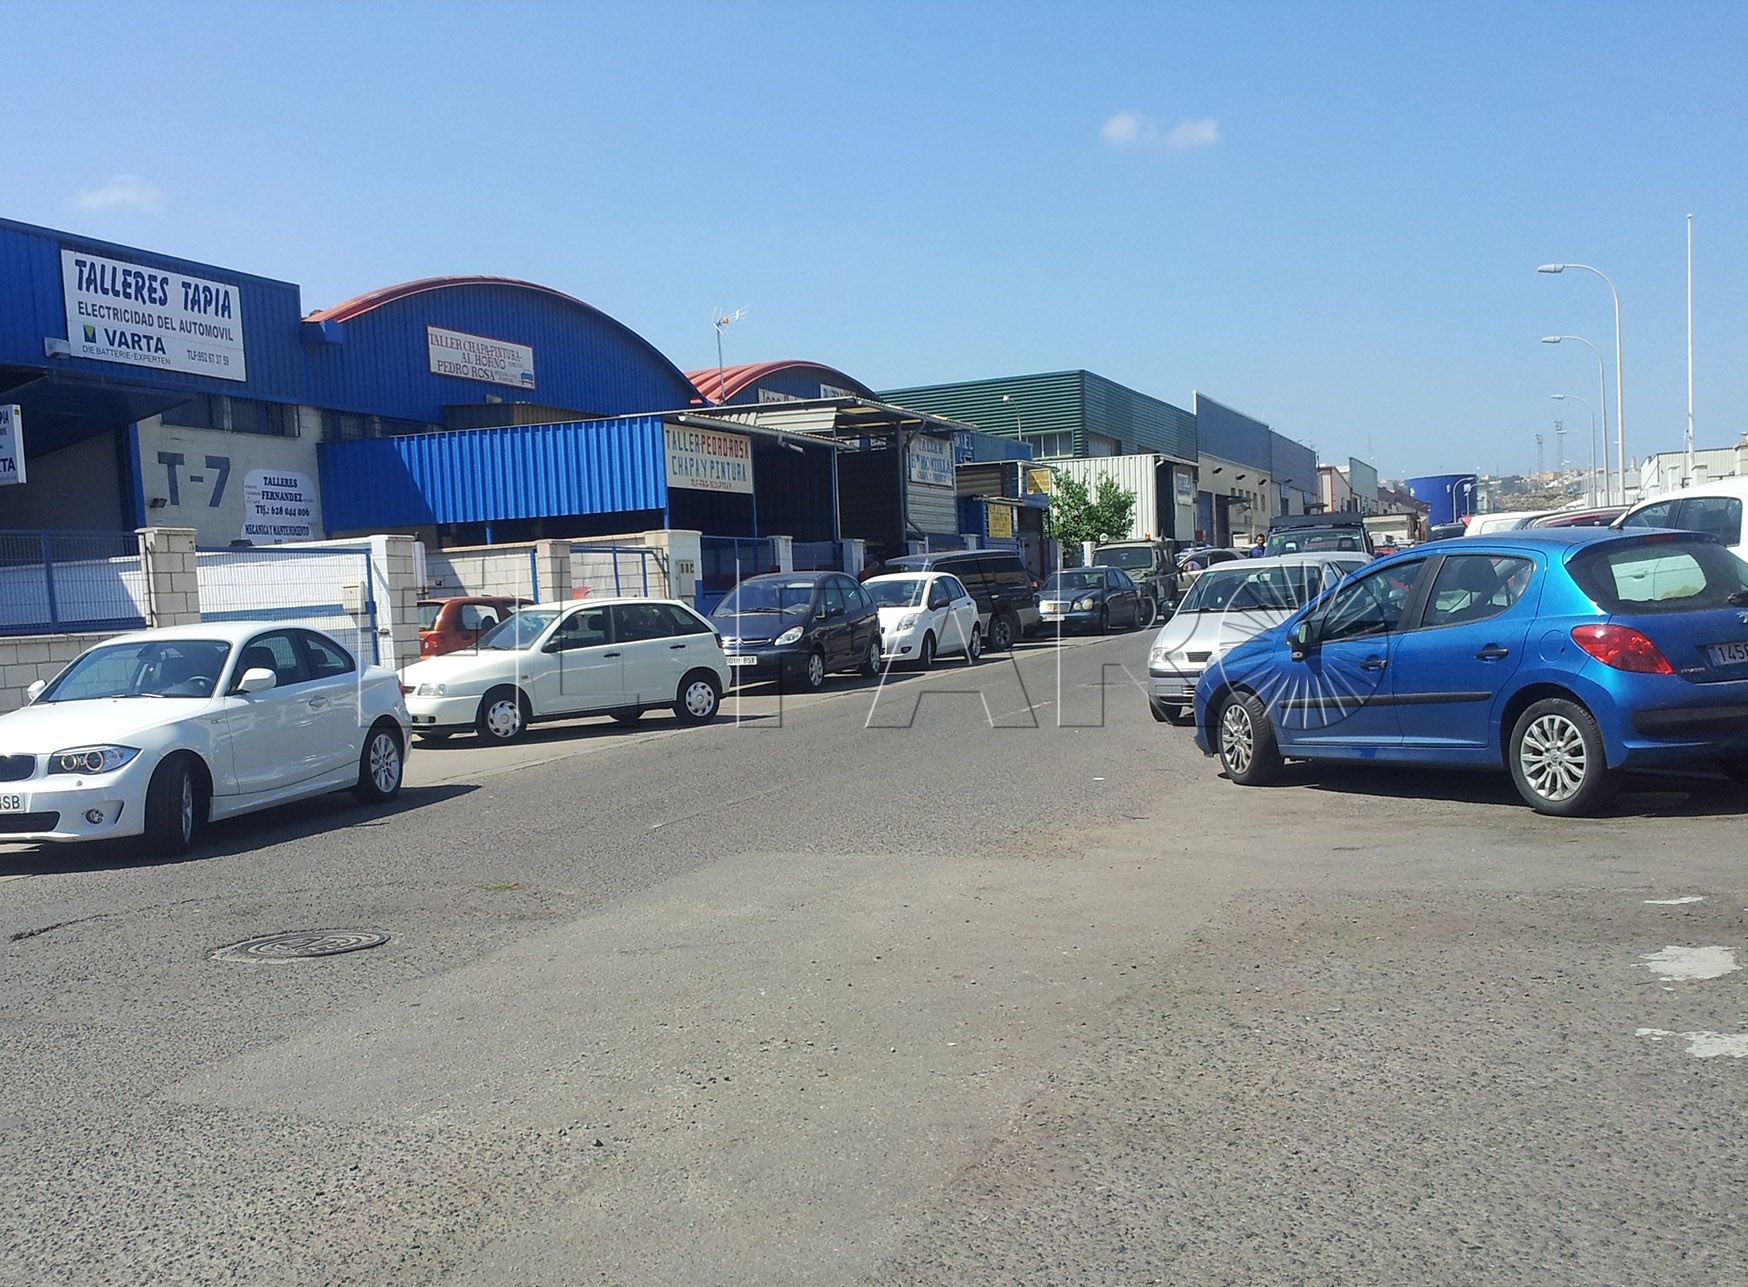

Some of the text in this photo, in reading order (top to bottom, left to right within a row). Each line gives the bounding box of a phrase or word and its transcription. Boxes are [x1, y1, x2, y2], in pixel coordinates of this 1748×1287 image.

[74, 259, 232, 319] TALLERES TAPIA
[78, 301, 234, 341] ELECTRICIDAD DEL AUTOMOVIL
[82, 345, 95, 354] DIE
[104, 328, 167, 355] VARTA
[431, 333, 464, 350] TALLER
[437, 360, 469, 376] PEDRO
[471, 366, 496, 380] ROSA
[461, 352, 473, 364] AL
[475, 354, 506, 370] HORNO
[666, 430, 700, 453] TALLER
[671, 455, 699, 477] CHAPA
[710, 460, 747, 482] PINTURA
[158, 451, 230, 507] T-7
[263, 476, 298, 489] TALLERES
[261, 490, 303, 502] FERNANDEZ
[271, 506, 283, 516] 628
[284, 507, 297, 517] 044
[297, 508, 310, 517] 006
[245, 524, 269, 535] MECANICA
[273, 525, 309, 536] MANTENIMIENTO
[0, 795, 20, 809] SB
